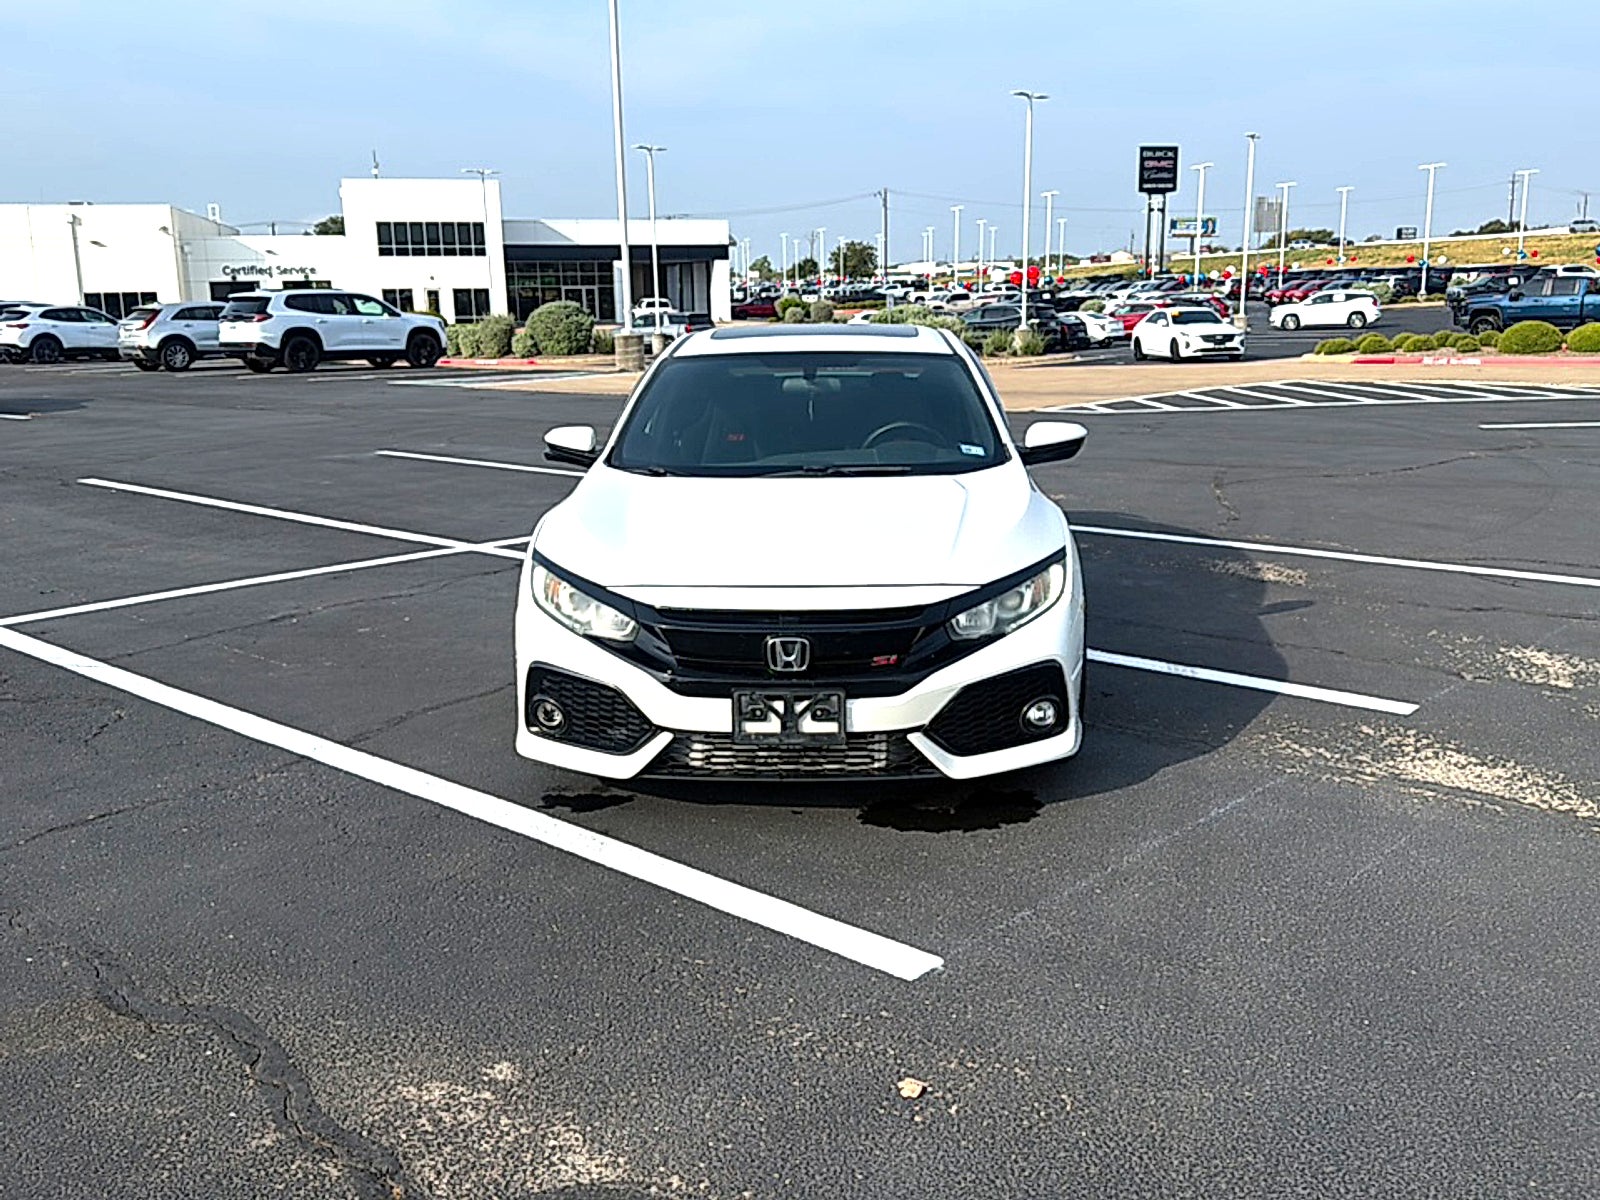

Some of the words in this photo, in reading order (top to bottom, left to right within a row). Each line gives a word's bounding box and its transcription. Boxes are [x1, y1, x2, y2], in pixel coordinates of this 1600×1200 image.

[1142, 150, 1175, 158] BUICK
[1143, 160, 1174, 168] GMC
[222, 265, 273, 278] Certified
[276, 265, 317, 276] Service
